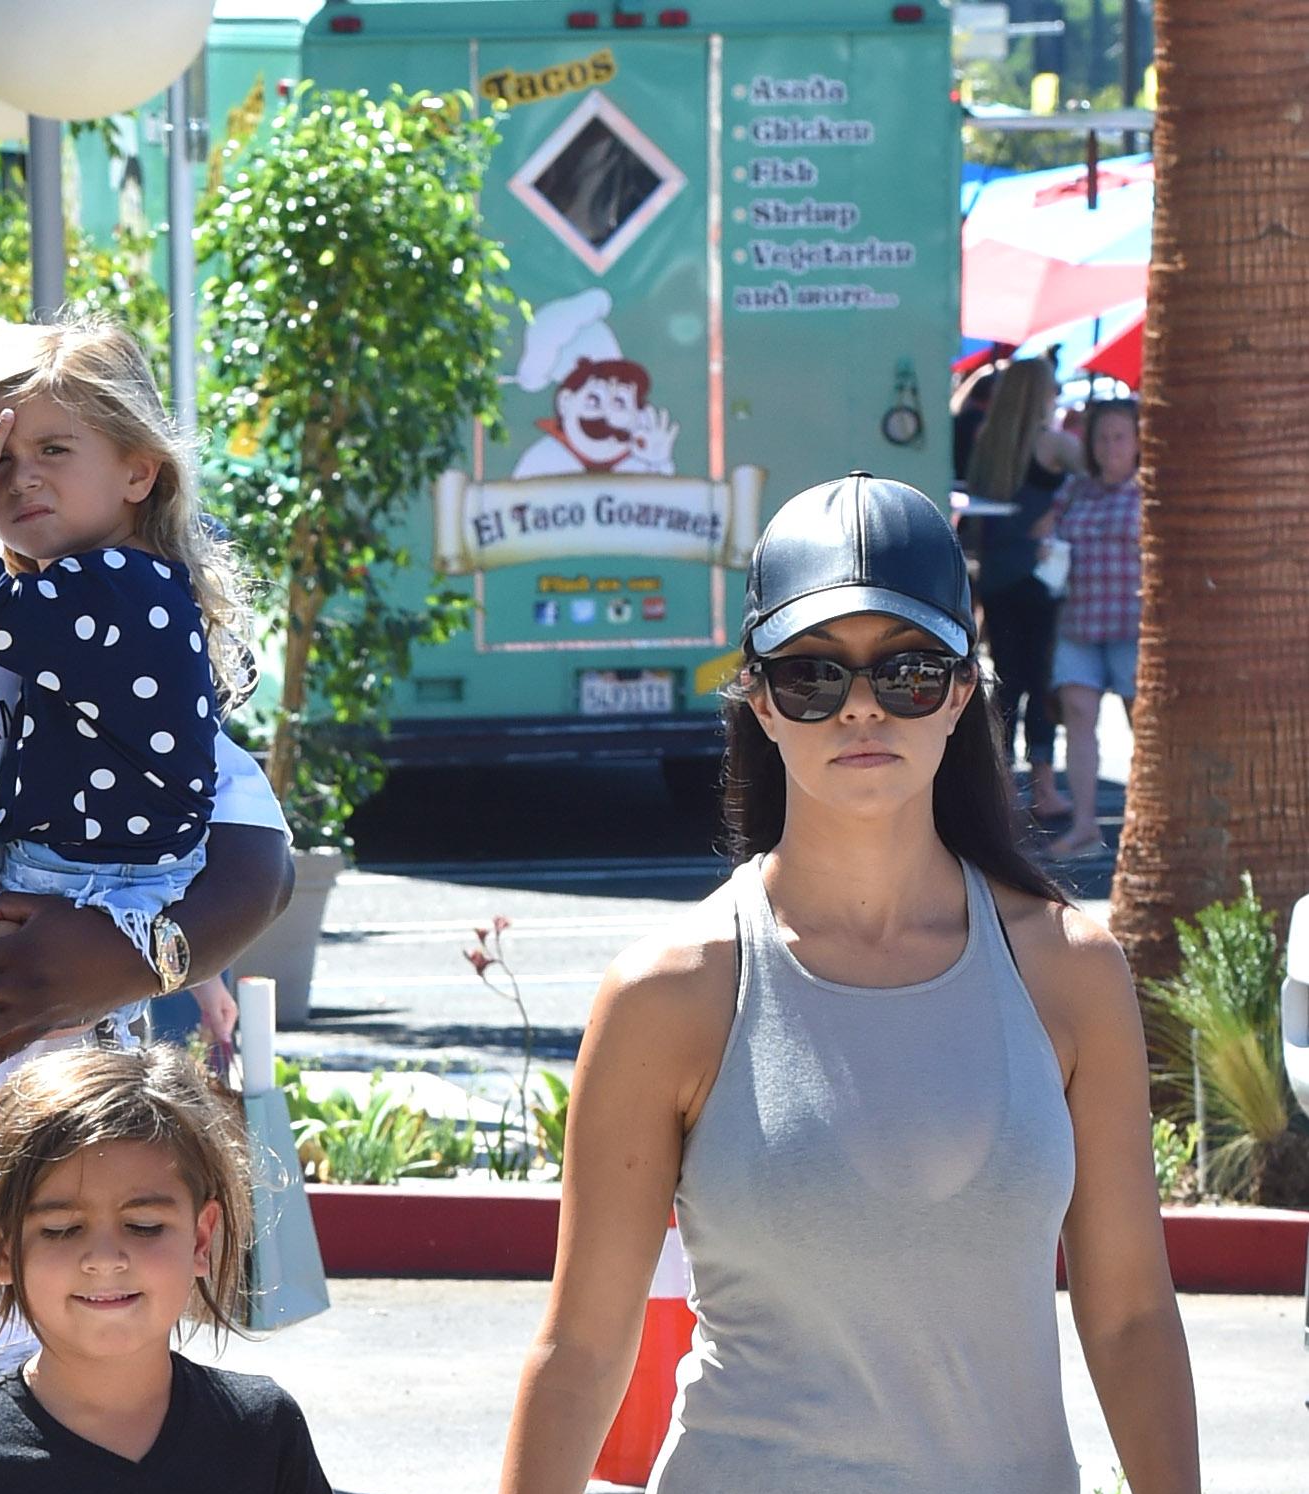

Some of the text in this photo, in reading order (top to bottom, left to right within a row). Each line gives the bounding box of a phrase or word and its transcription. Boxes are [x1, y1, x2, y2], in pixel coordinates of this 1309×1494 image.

[480, 47, 616, 105] Tacos
[750, 74, 847, 105] Asada
[749, 157, 818, 187] Fish
[750, 198, 860, 233] Shrimp
[748, 237, 916, 275] Vegetarian
[473, 494, 723, 547] El Taco Gourmet
